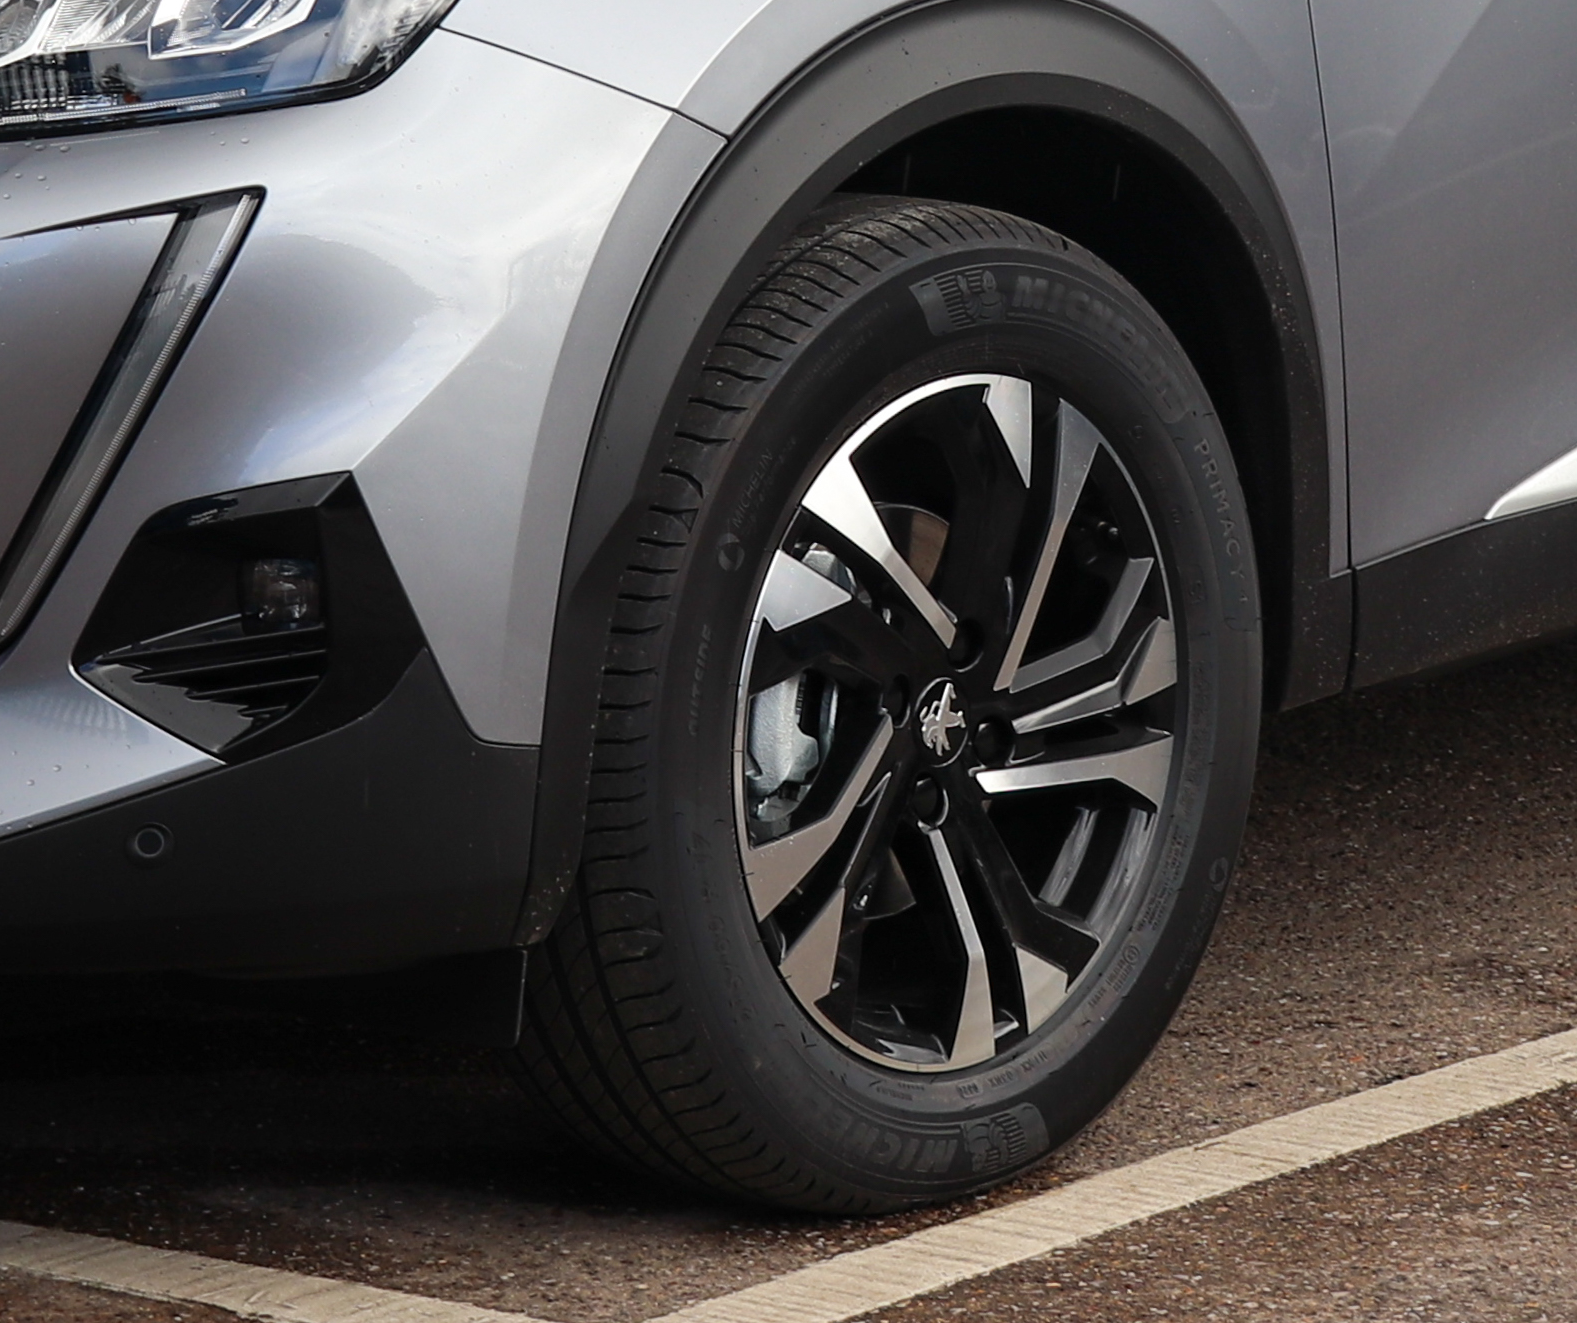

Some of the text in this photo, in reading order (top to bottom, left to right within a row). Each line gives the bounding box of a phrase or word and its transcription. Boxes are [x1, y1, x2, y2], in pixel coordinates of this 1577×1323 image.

[1011, 275, 1189, 411] MICHELIN
[731, 448, 774, 529] MICHELIN
[1193, 437, 1245, 579] PRIMACY
[688, 624, 711, 737] OUTSIDE
